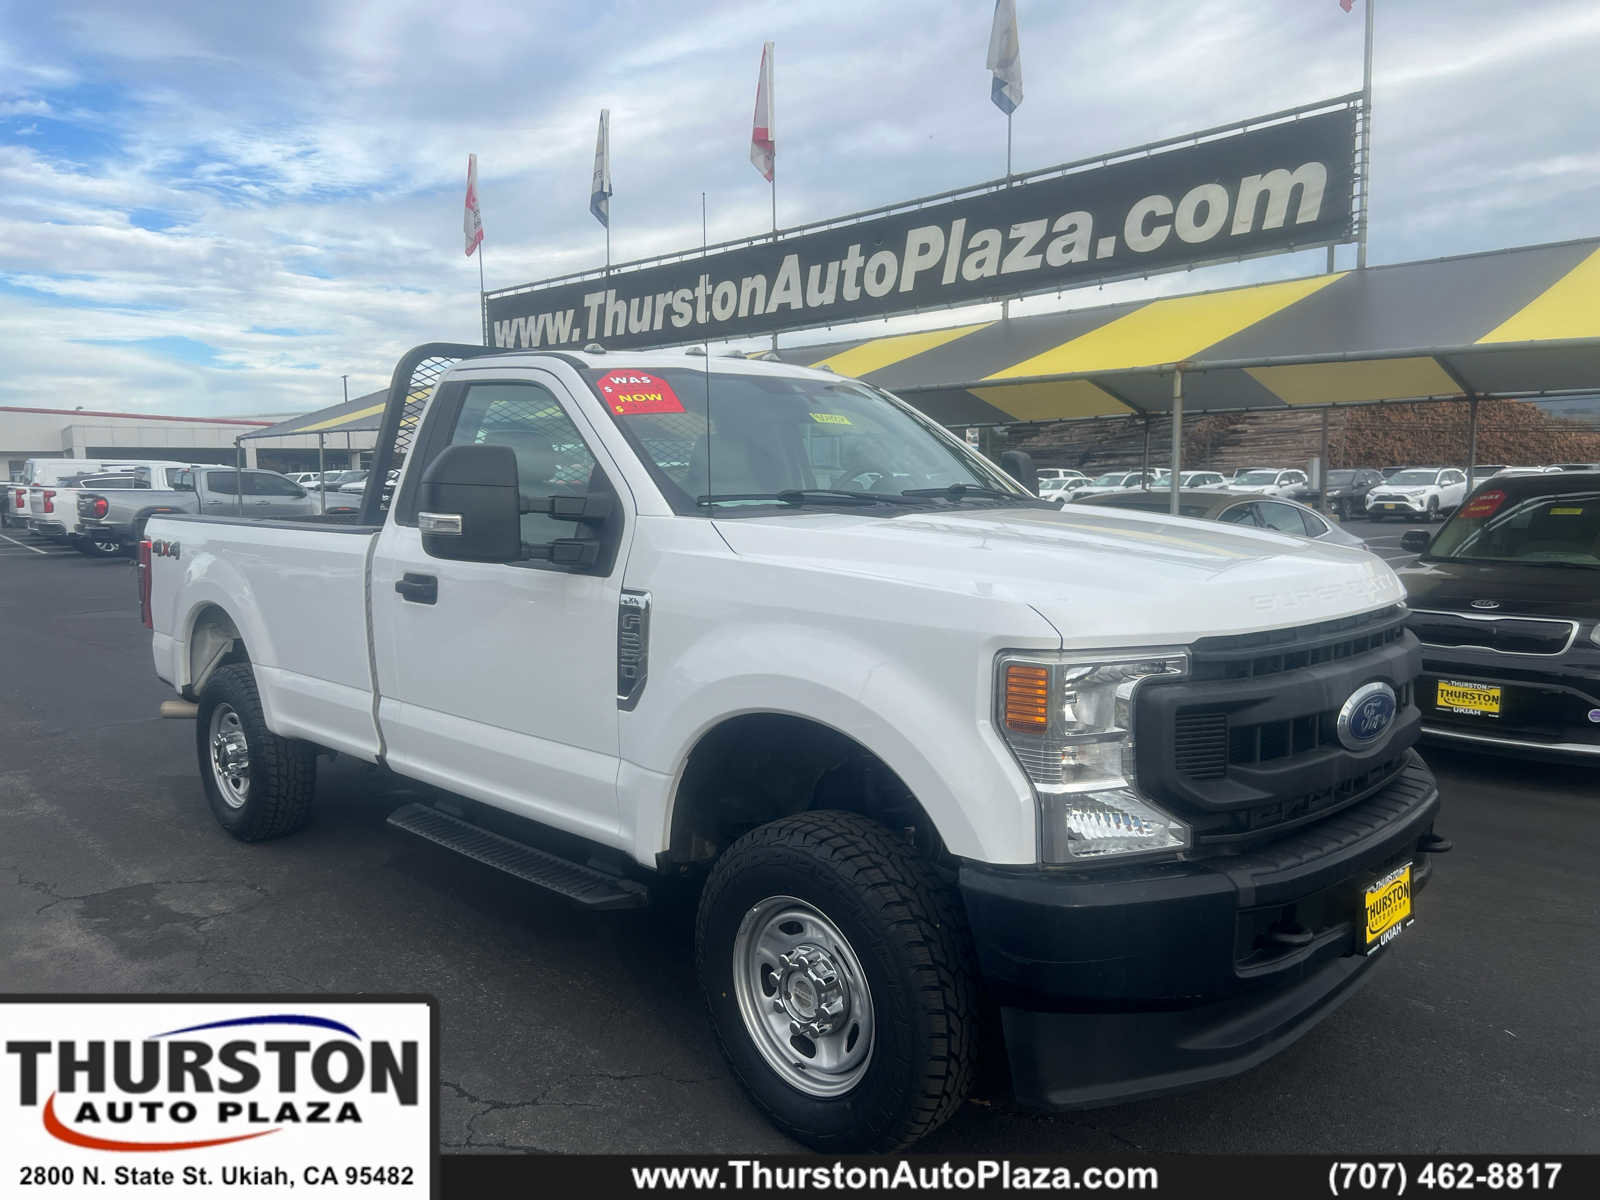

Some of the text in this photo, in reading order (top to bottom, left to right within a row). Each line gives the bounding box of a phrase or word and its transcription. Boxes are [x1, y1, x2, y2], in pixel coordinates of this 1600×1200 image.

[493, 161, 1328, 349] www.ThurstonAutoPlaza.com
[609, 376, 652, 385] WAS
[618, 393, 662, 403] NOW
[1440, 689, 1499, 705] THURSTON
[1453, 706, 1481, 716] UKIAH
[1380, 922, 1402, 946] UKIAH
